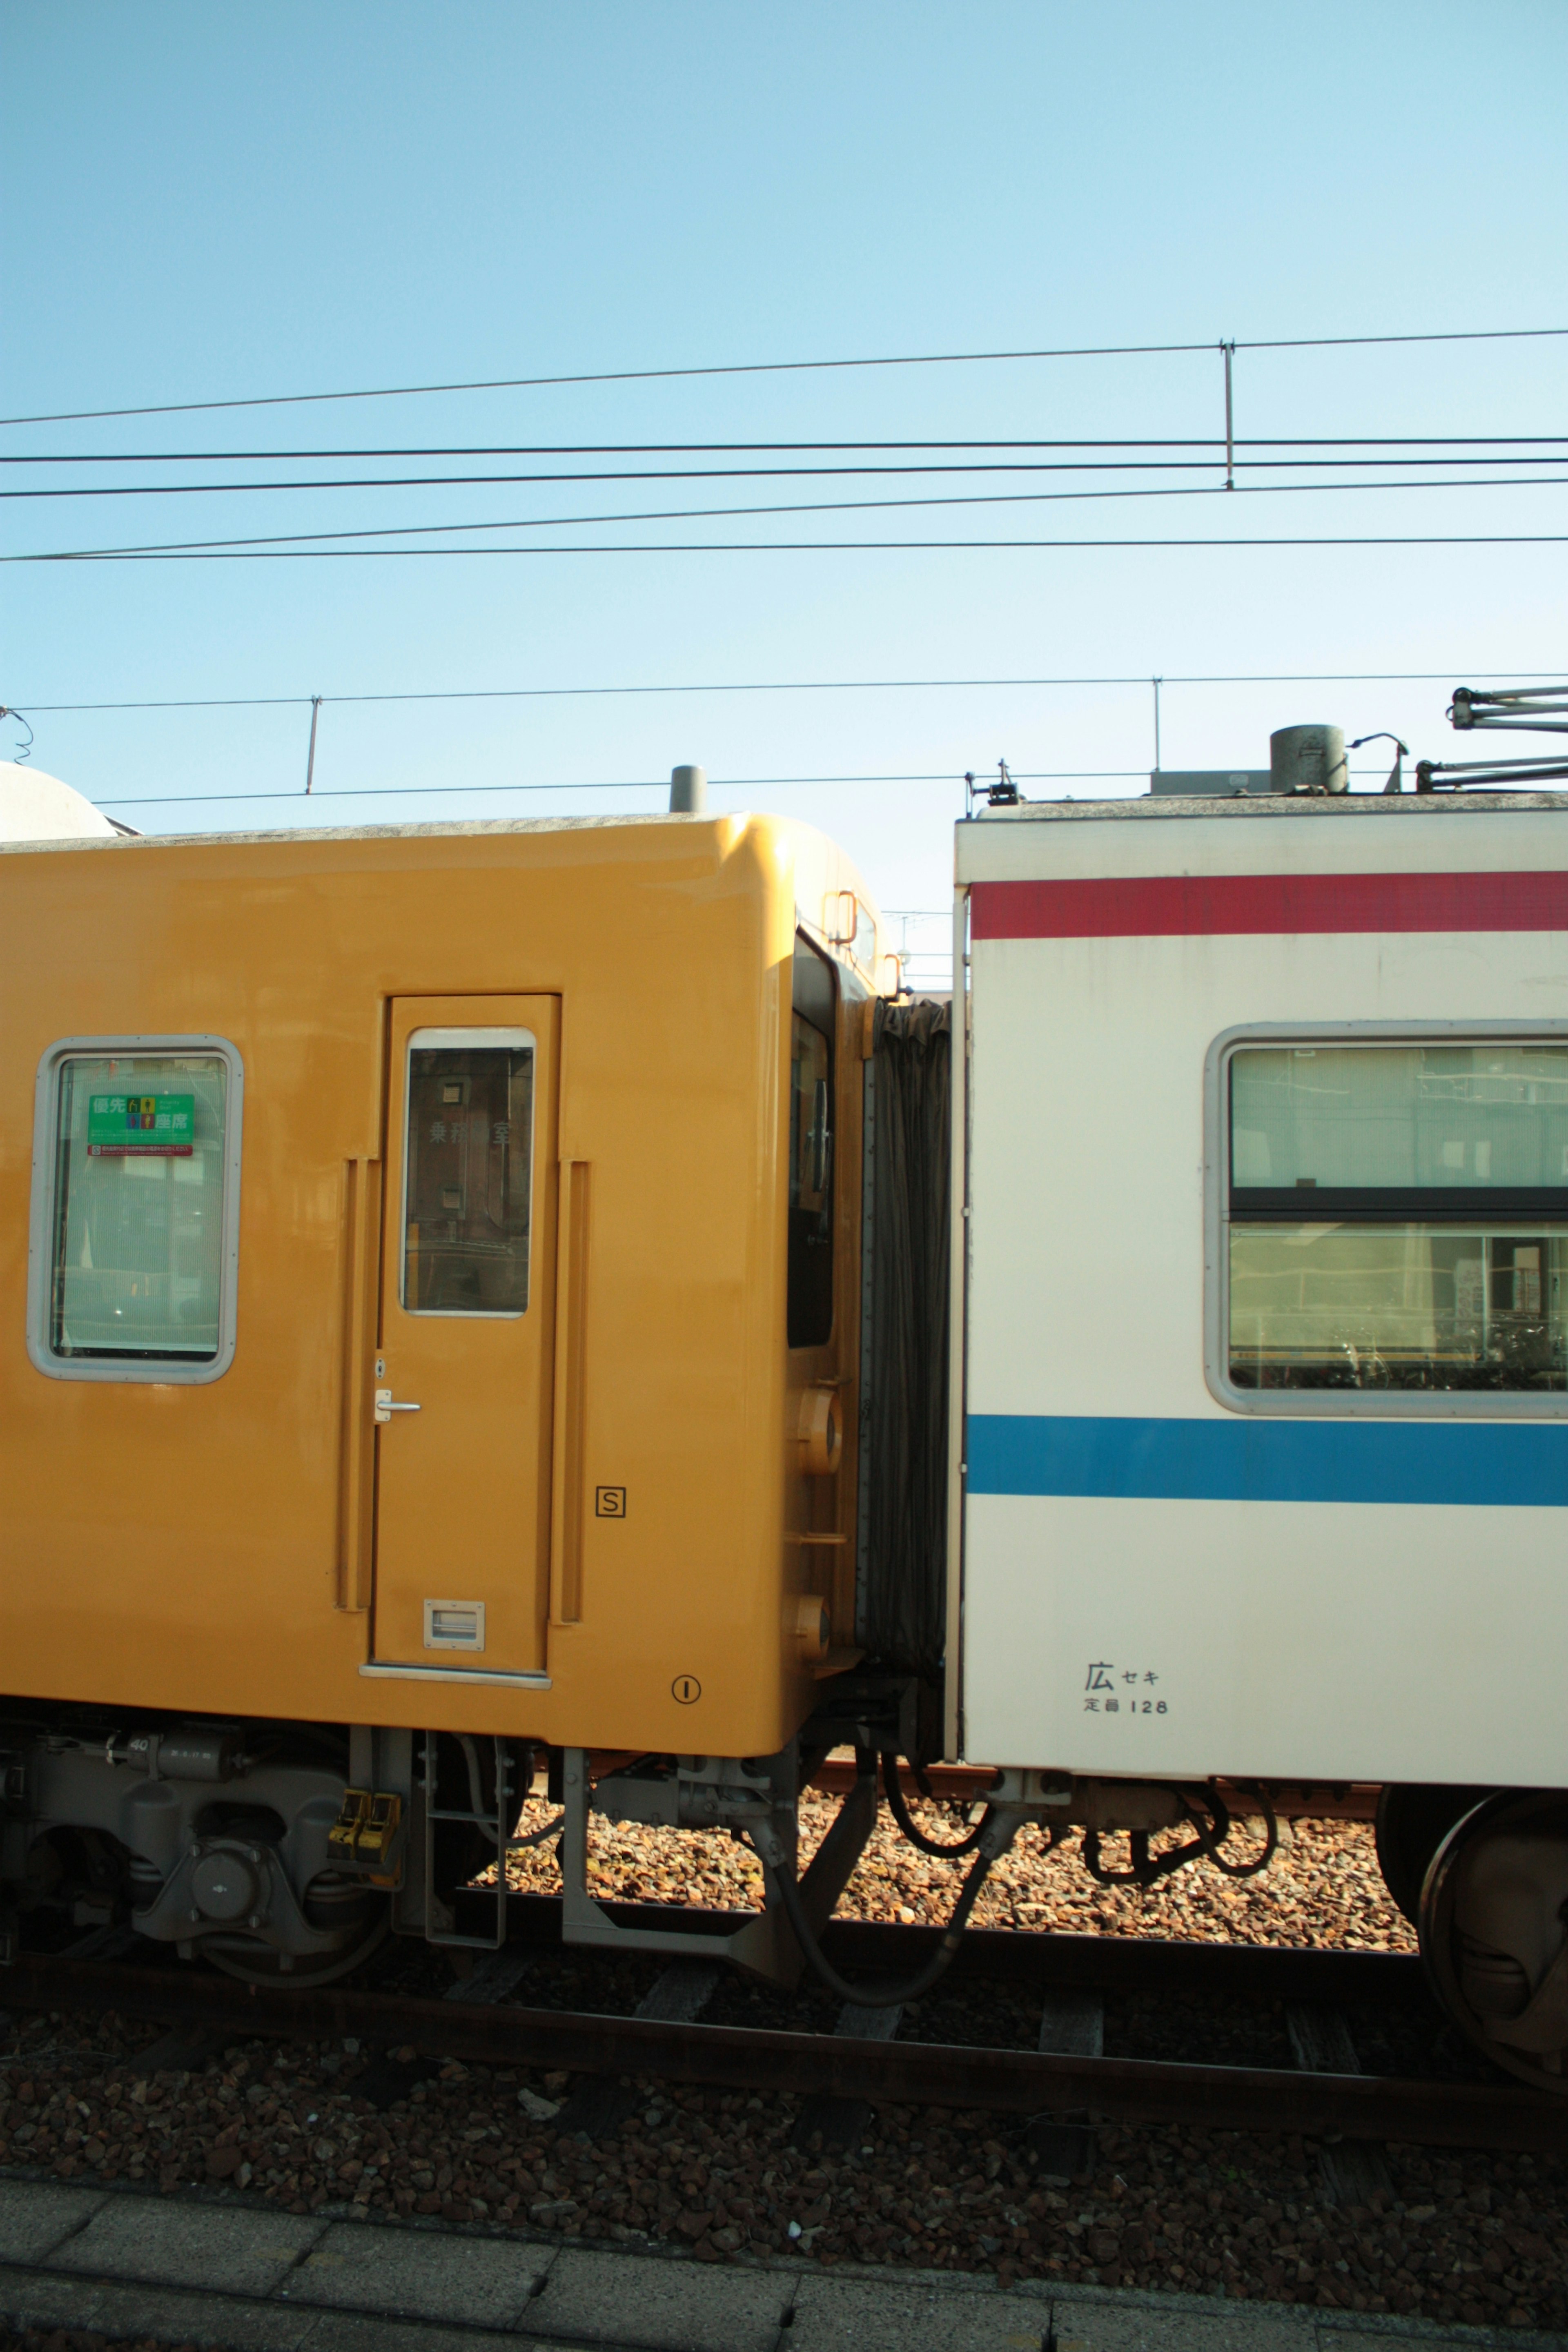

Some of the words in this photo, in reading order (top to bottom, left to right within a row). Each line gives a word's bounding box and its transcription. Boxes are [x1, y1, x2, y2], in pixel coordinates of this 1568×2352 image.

[94, 1097, 125, 1114] 優先
[155, 1113, 187, 1129] 座席
[603, 1492, 618, 1512] S
[1084, 1698, 1119, 1712] 定員
[1131, 1700, 1168, 1714] 128
[131, 1739, 148, 1751] 40
